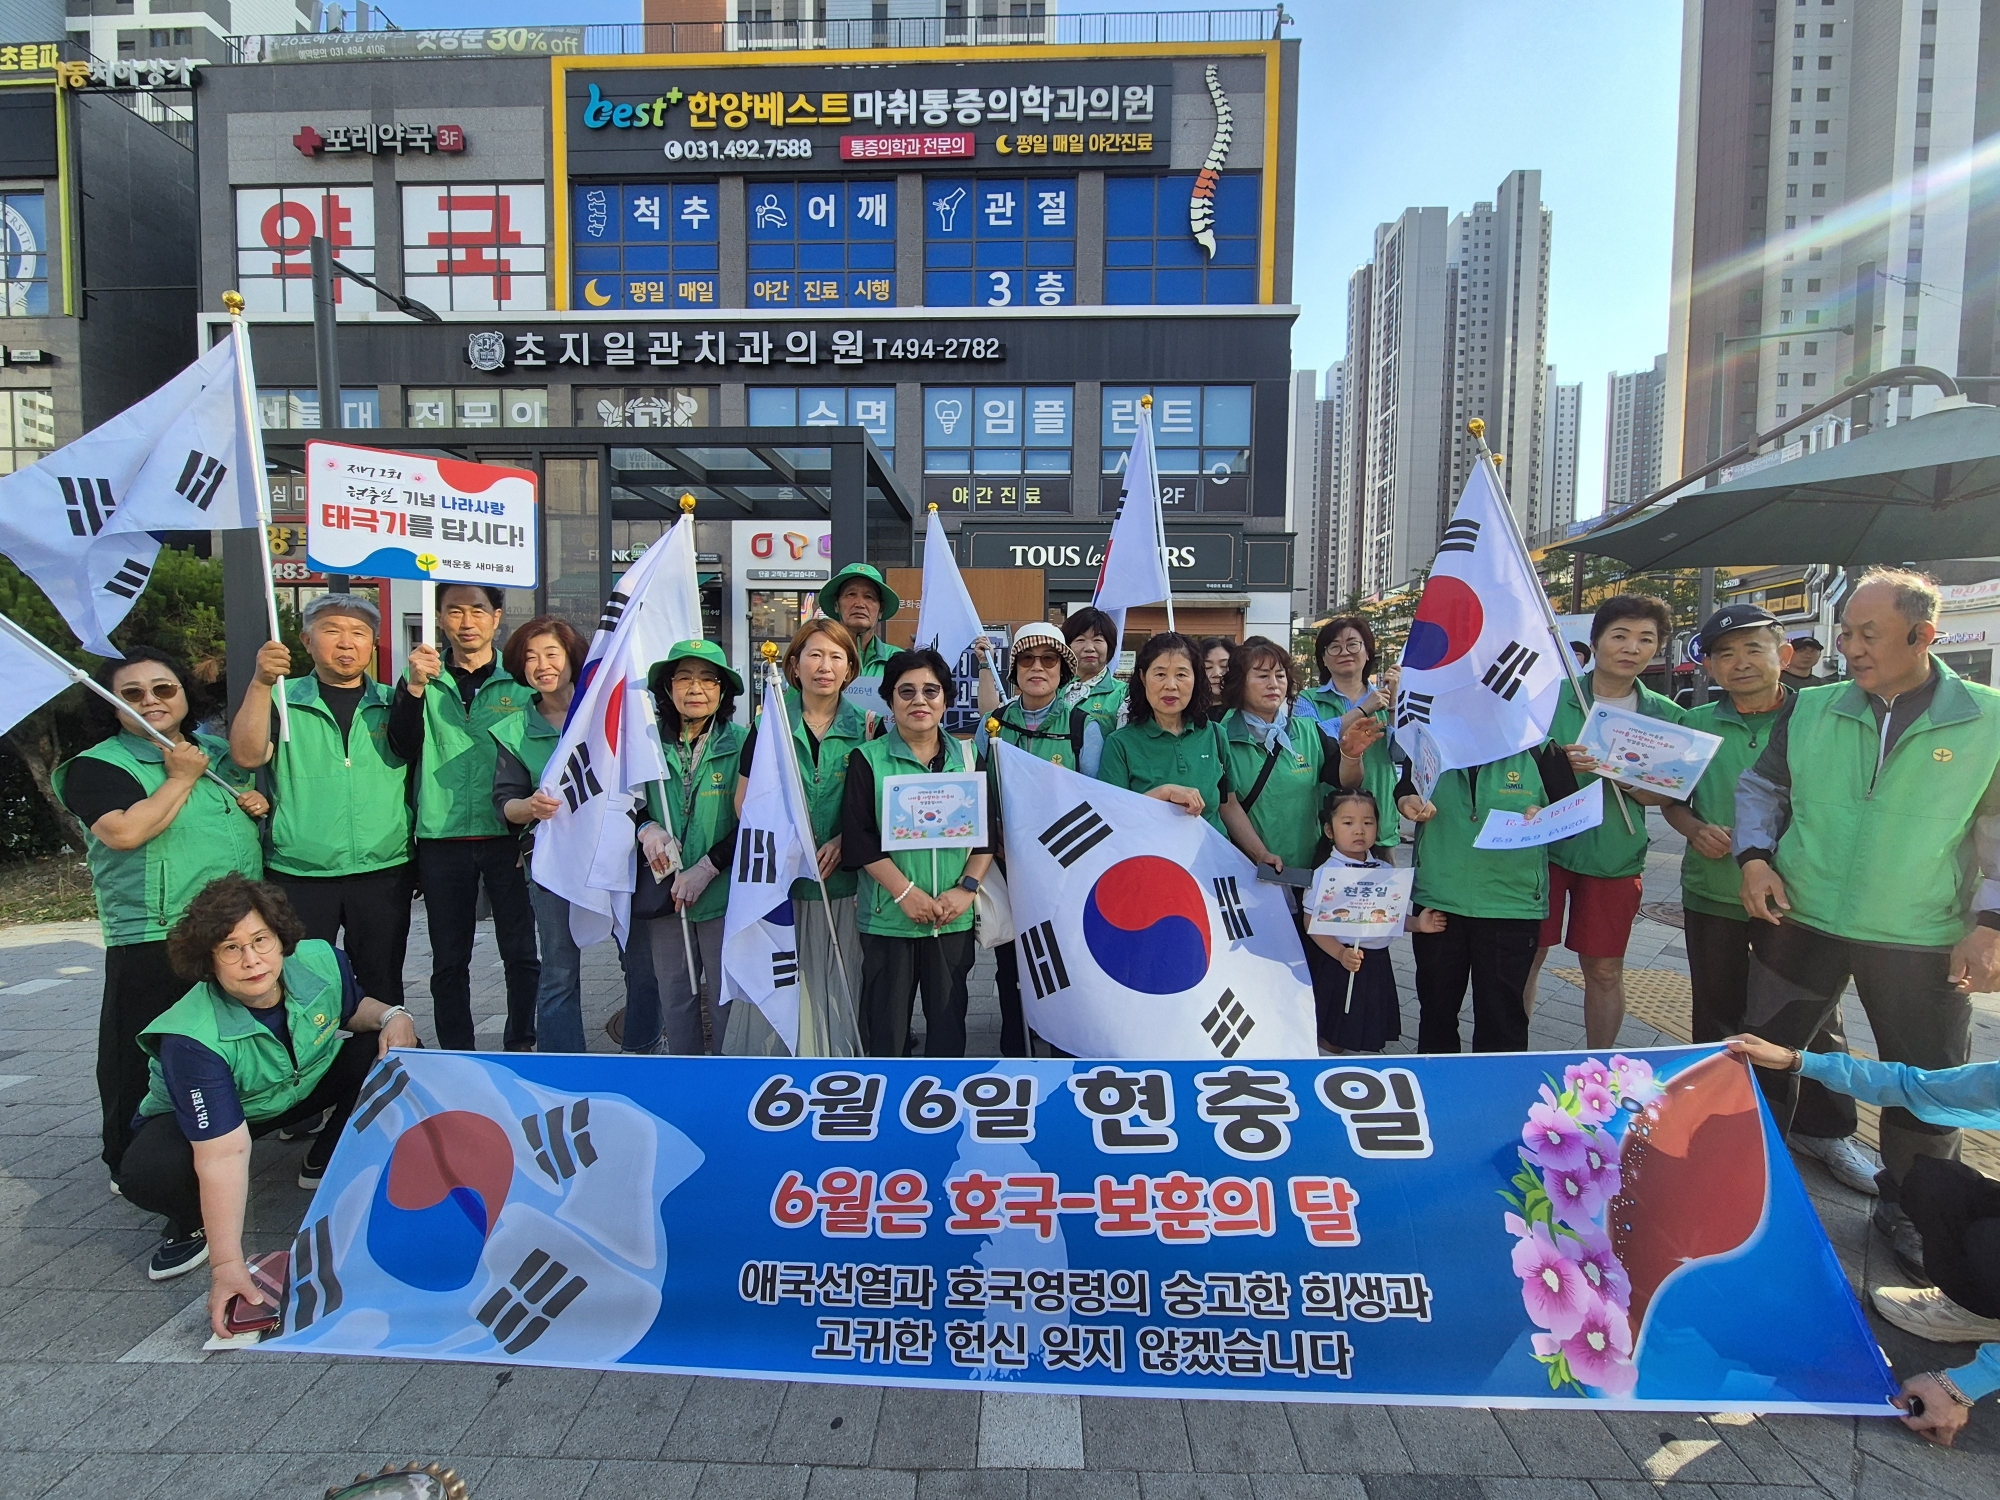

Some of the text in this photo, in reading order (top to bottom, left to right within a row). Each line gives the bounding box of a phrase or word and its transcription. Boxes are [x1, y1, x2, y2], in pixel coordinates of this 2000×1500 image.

[487, 27, 548, 51] 30%
[0, 44, 58, 70] 초음파
[325, 124, 459, 154] 포레약국 3F
[683, 138, 813, 161] 031.492.7588
[850, 135, 966, 157] 통증의학과 전문의
[1016, 132, 1154, 155] 평일 매일 야간진료
[629, 280, 715, 304] 평일 매일
[752, 279, 891, 303] 야간 진료 시행
[513, 329, 1000, 368] 초지일관치과의원 T494-2782
[402, 490, 506, 516] 기념 나라사랑
[321, 503, 525, 548] 태극기를 답시다!
[442, 558, 515, 574] 백운동 새마을회
[1009, 545, 1081, 567] TOUS
[749, 1072, 887, 1141] 6월
[902, 1074, 1037, 1143] 6일
[771, 1169, 1361, 1247] 6월은 호국-보훈의 달
[740, 1261, 1432, 1322] 애국선열과 호국영령의 숭고한 희생과
[813, 1317, 1353, 1379] 고귀한 헌신 잊지 않겠습니다
